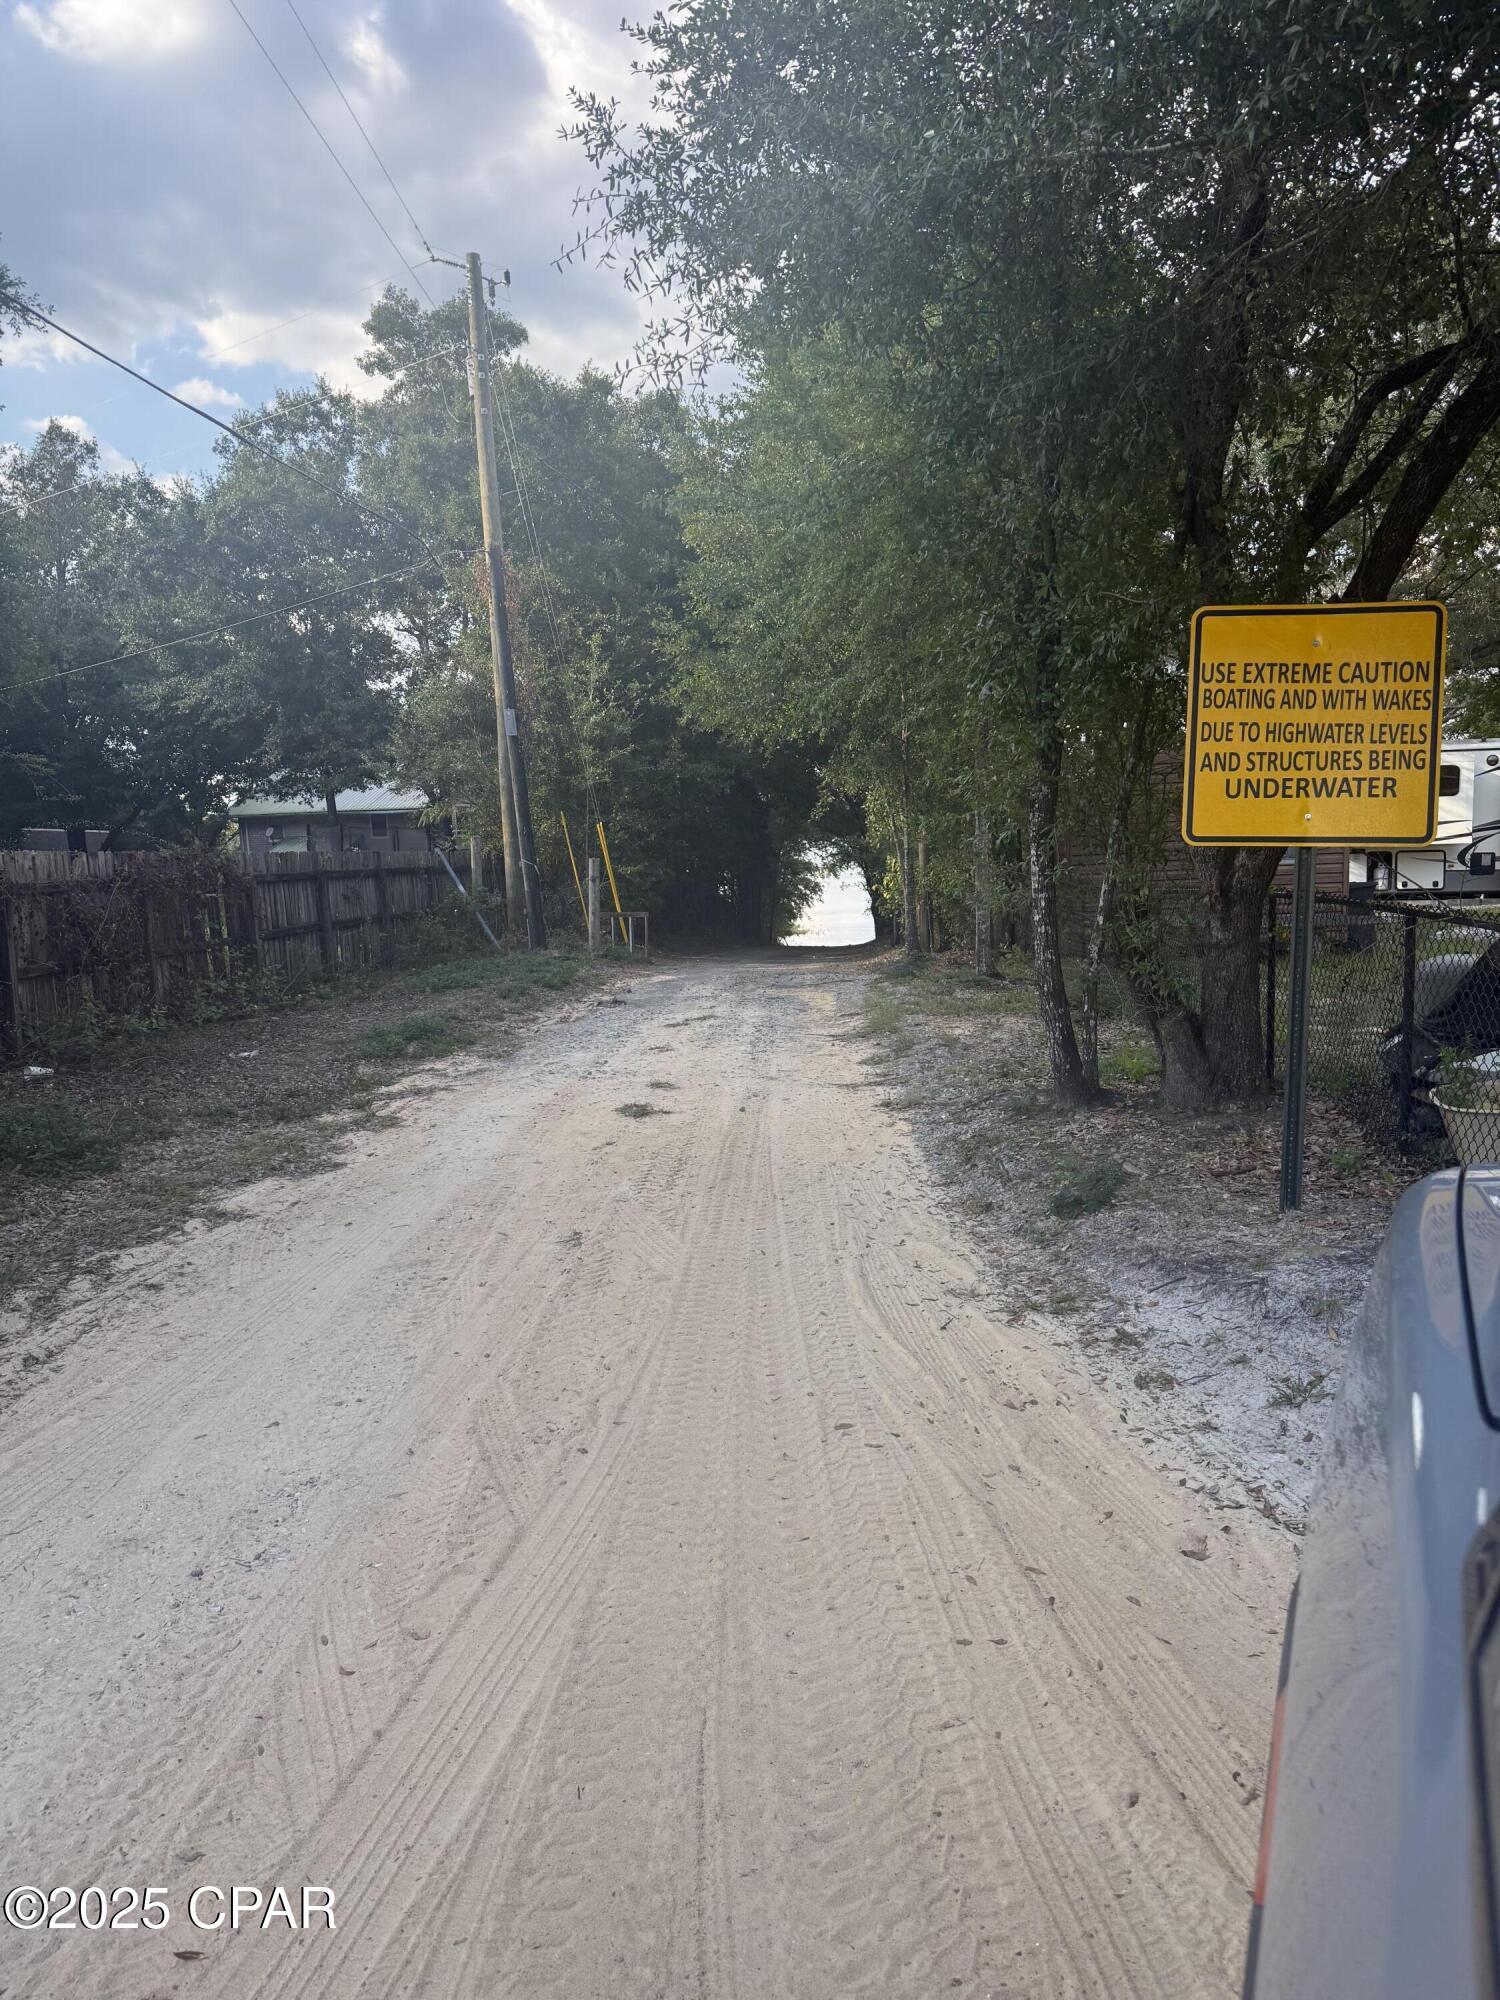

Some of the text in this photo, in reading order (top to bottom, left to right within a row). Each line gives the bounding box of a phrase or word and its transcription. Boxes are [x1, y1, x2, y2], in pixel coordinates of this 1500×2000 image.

[1201, 661, 1430, 684] USE EXTREME CAUTION
[1202, 688, 1432, 711] BOATING AND WITH WAKES
[1200, 721, 1233, 742] DUE
[1239, 722, 1260, 742] TO
[1369, 723, 1428, 745] LEVELS
[1200, 749, 1427, 772] AND STRUCTURES BEING
[1225, 777, 1397, 798] UNDERWATER
